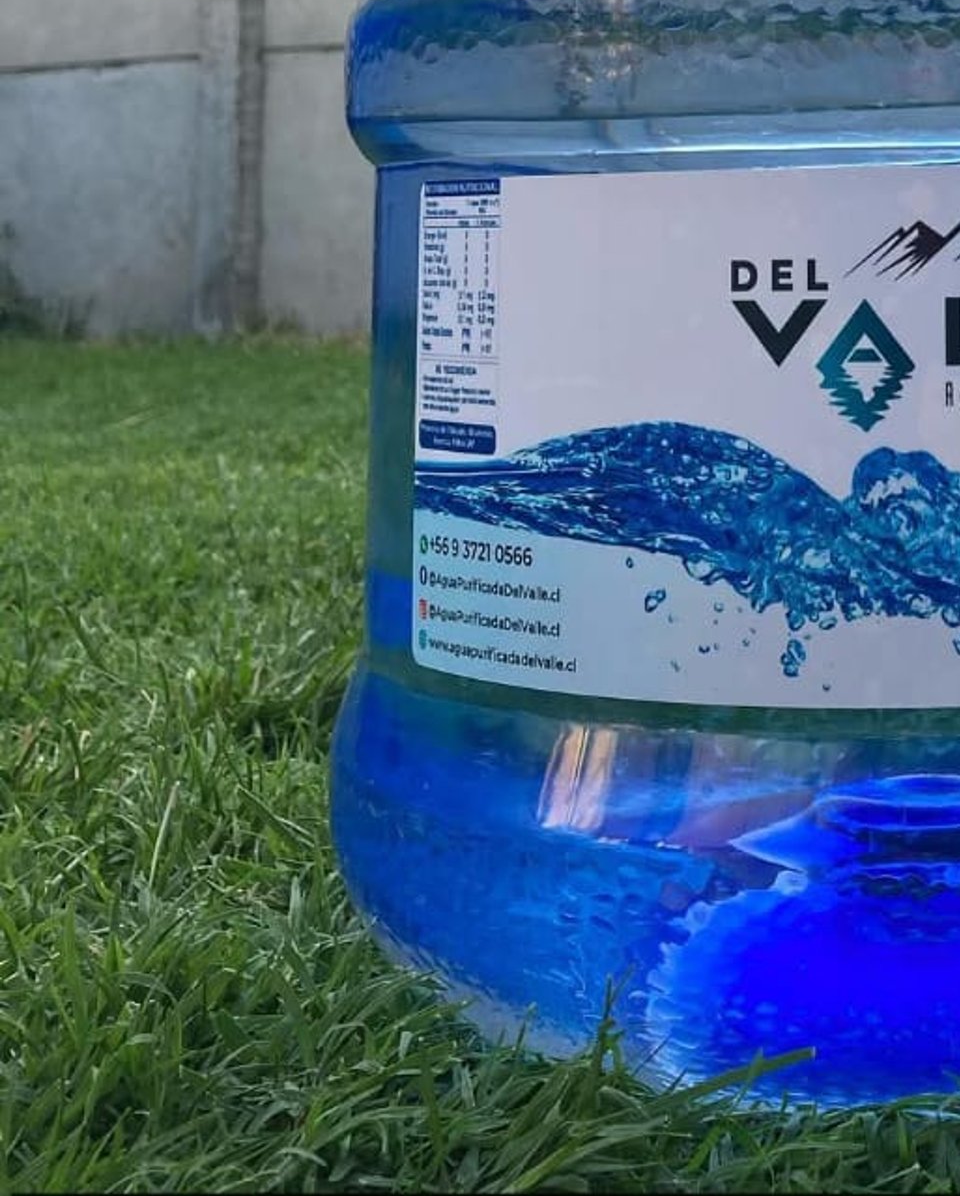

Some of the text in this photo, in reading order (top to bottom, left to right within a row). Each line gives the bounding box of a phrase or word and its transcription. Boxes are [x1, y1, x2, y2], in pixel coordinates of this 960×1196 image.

[730, 259, 829, 292] DEL
[452, 538, 459, 557] 9
[463, 540, 491, 562] 3721
[494, 545, 533, 567] 0566
